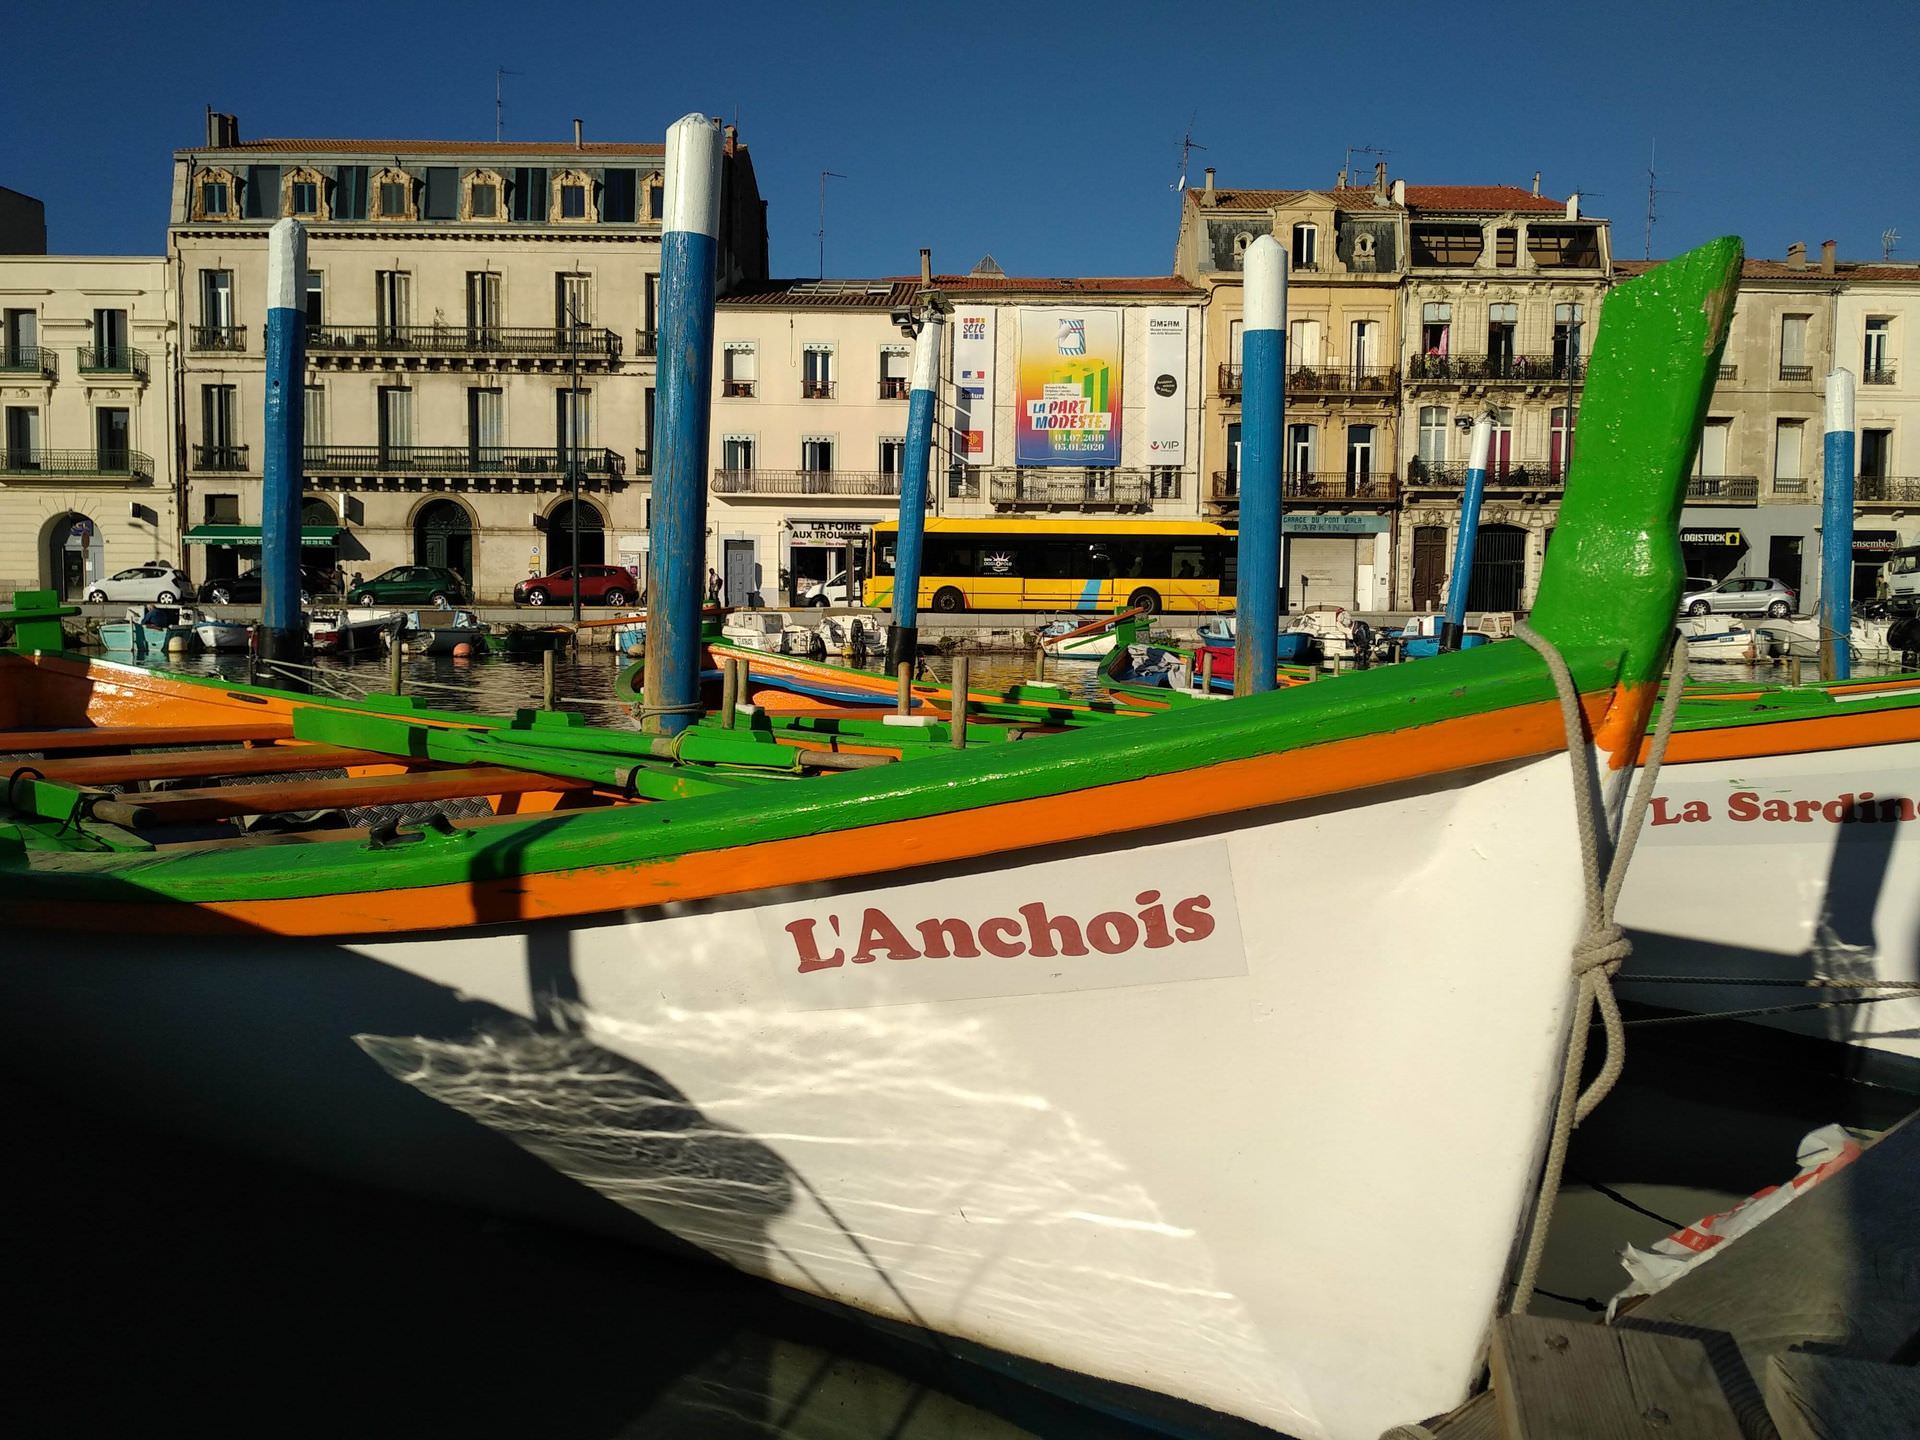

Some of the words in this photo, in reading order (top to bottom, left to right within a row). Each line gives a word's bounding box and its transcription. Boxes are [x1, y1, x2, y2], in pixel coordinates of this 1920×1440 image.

[1033, 403, 1046, 414] LA
[1049, 400, 1087, 414] PART
[1055, 443, 1105, 452] 05.01.2020
[1160, 441, 1180, 449] VIP
[811, 522, 825, 531] LA
[828, 522, 862, 531] FOIRE
[792, 531, 813, 539] AUX
[1679, 533, 1726, 542] LOGISTOCK
[1650, 796, 1712, 826] La
[785, 889, 1216, 974] L'Anchois
